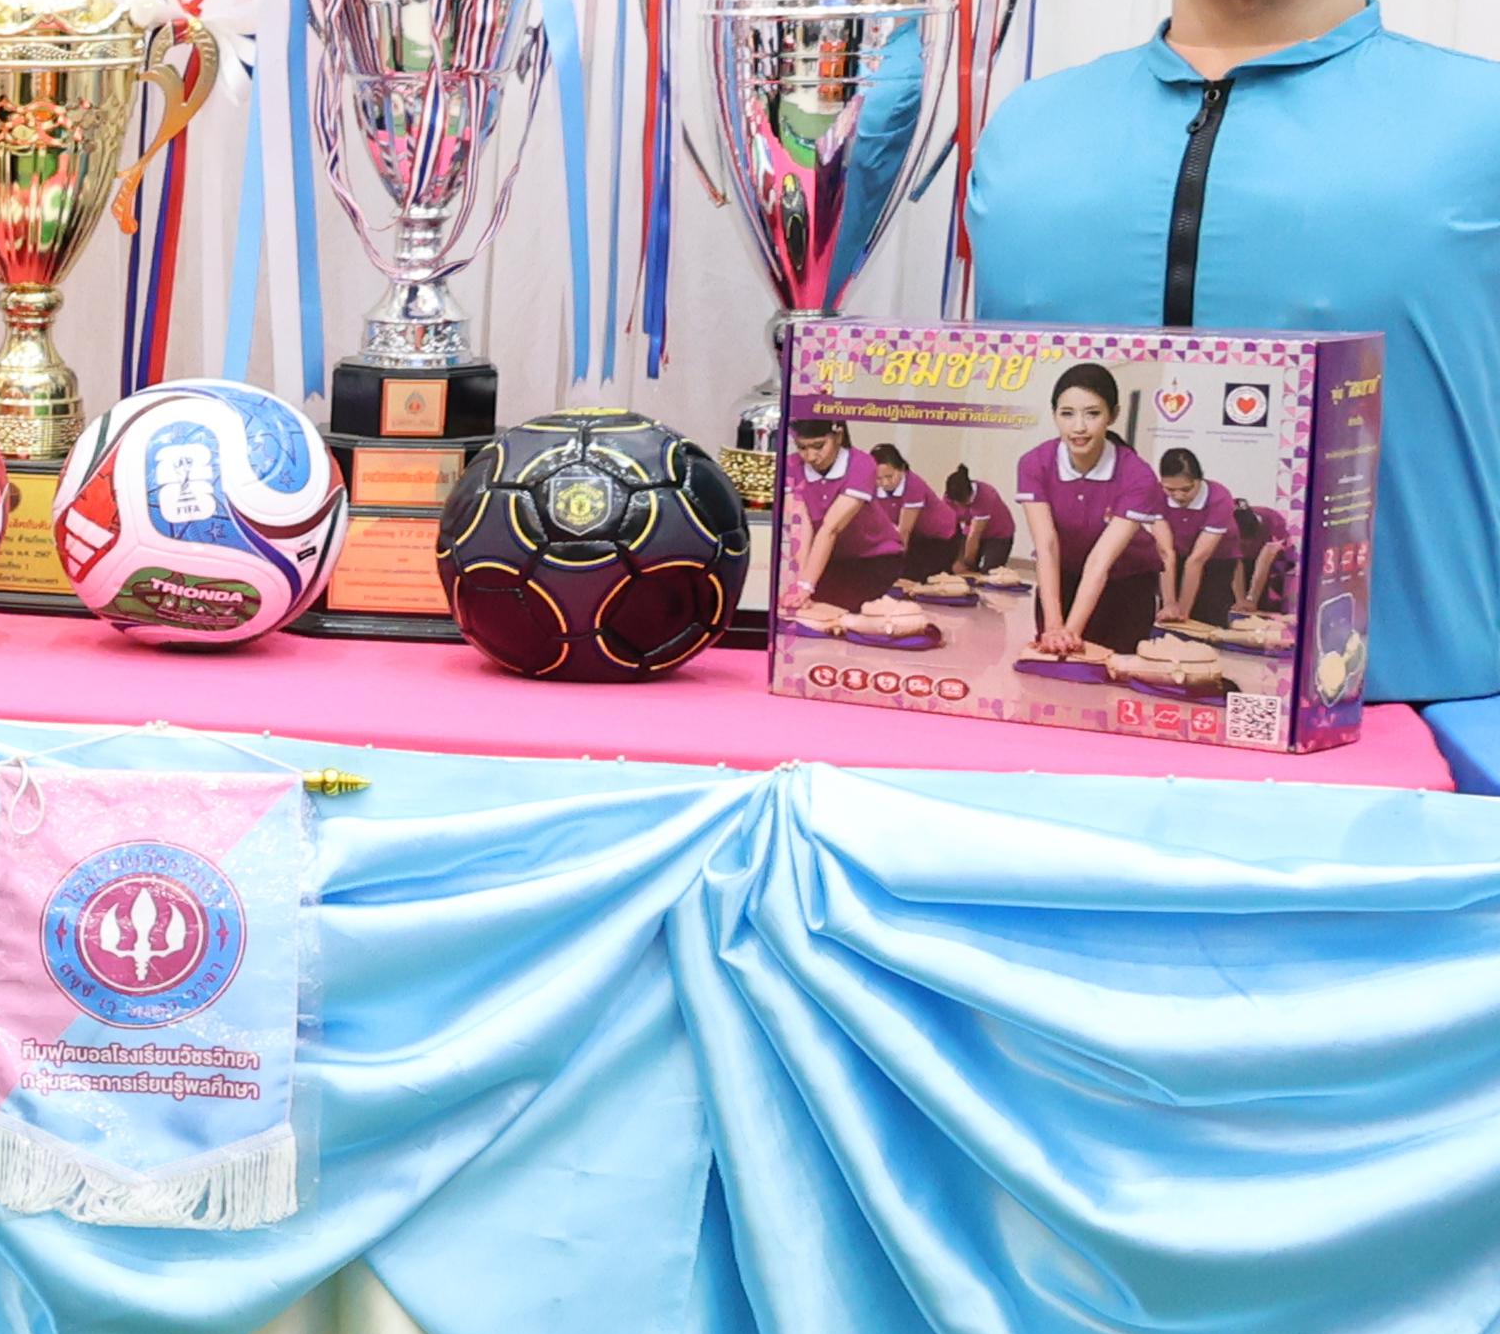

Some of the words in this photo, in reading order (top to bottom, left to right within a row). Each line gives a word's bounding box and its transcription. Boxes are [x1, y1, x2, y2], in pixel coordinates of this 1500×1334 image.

[176, 505, 201, 516] FIFA
[151, 577, 244, 602] TRIONDA
[21, 1037, 261, 1069] ทีมฟุตบอลโรงเรียนวัชรวิทยา
